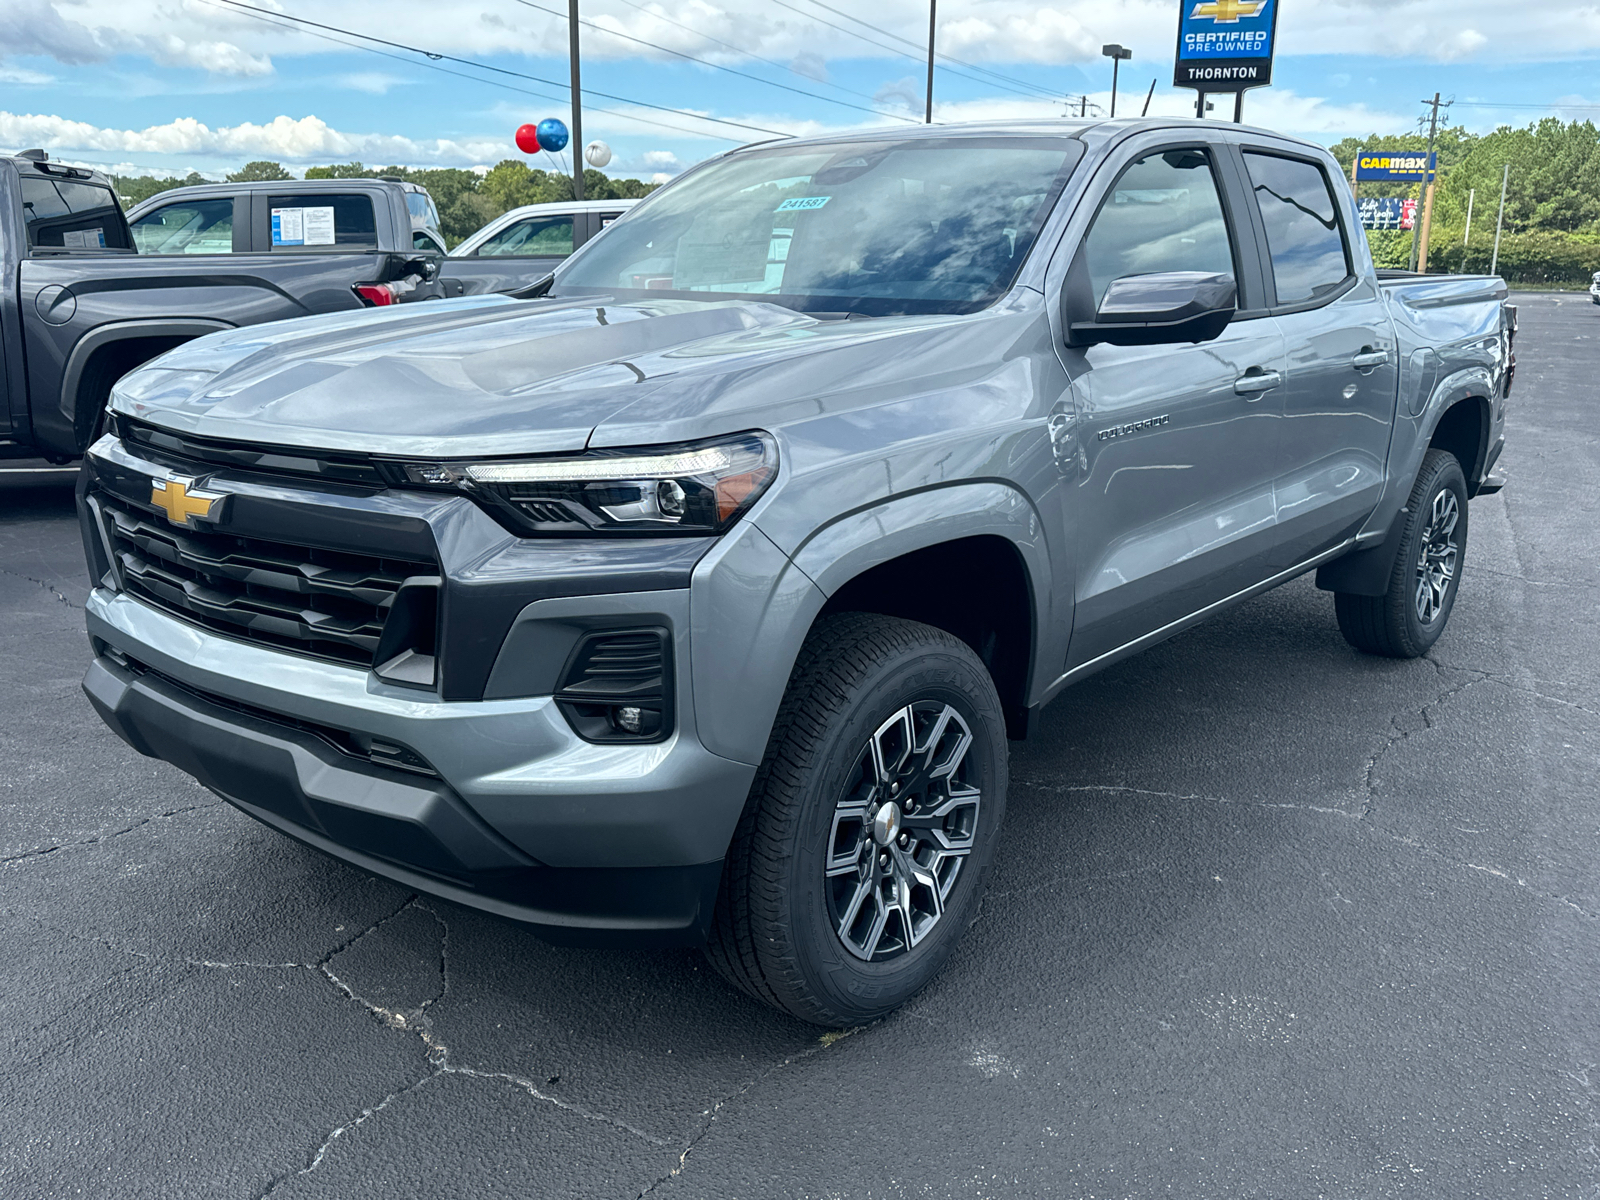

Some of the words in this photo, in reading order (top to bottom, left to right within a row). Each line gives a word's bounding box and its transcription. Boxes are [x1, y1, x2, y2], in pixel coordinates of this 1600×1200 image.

[1185, 31, 1267, 43] CERTIFIED
[1188, 42, 1262, 52] PRE-OWNED
[1188, 67, 1257, 79] THORNTON
[781, 198, 827, 209] 241587
[1098, 414, 1170, 441] COLORADO
